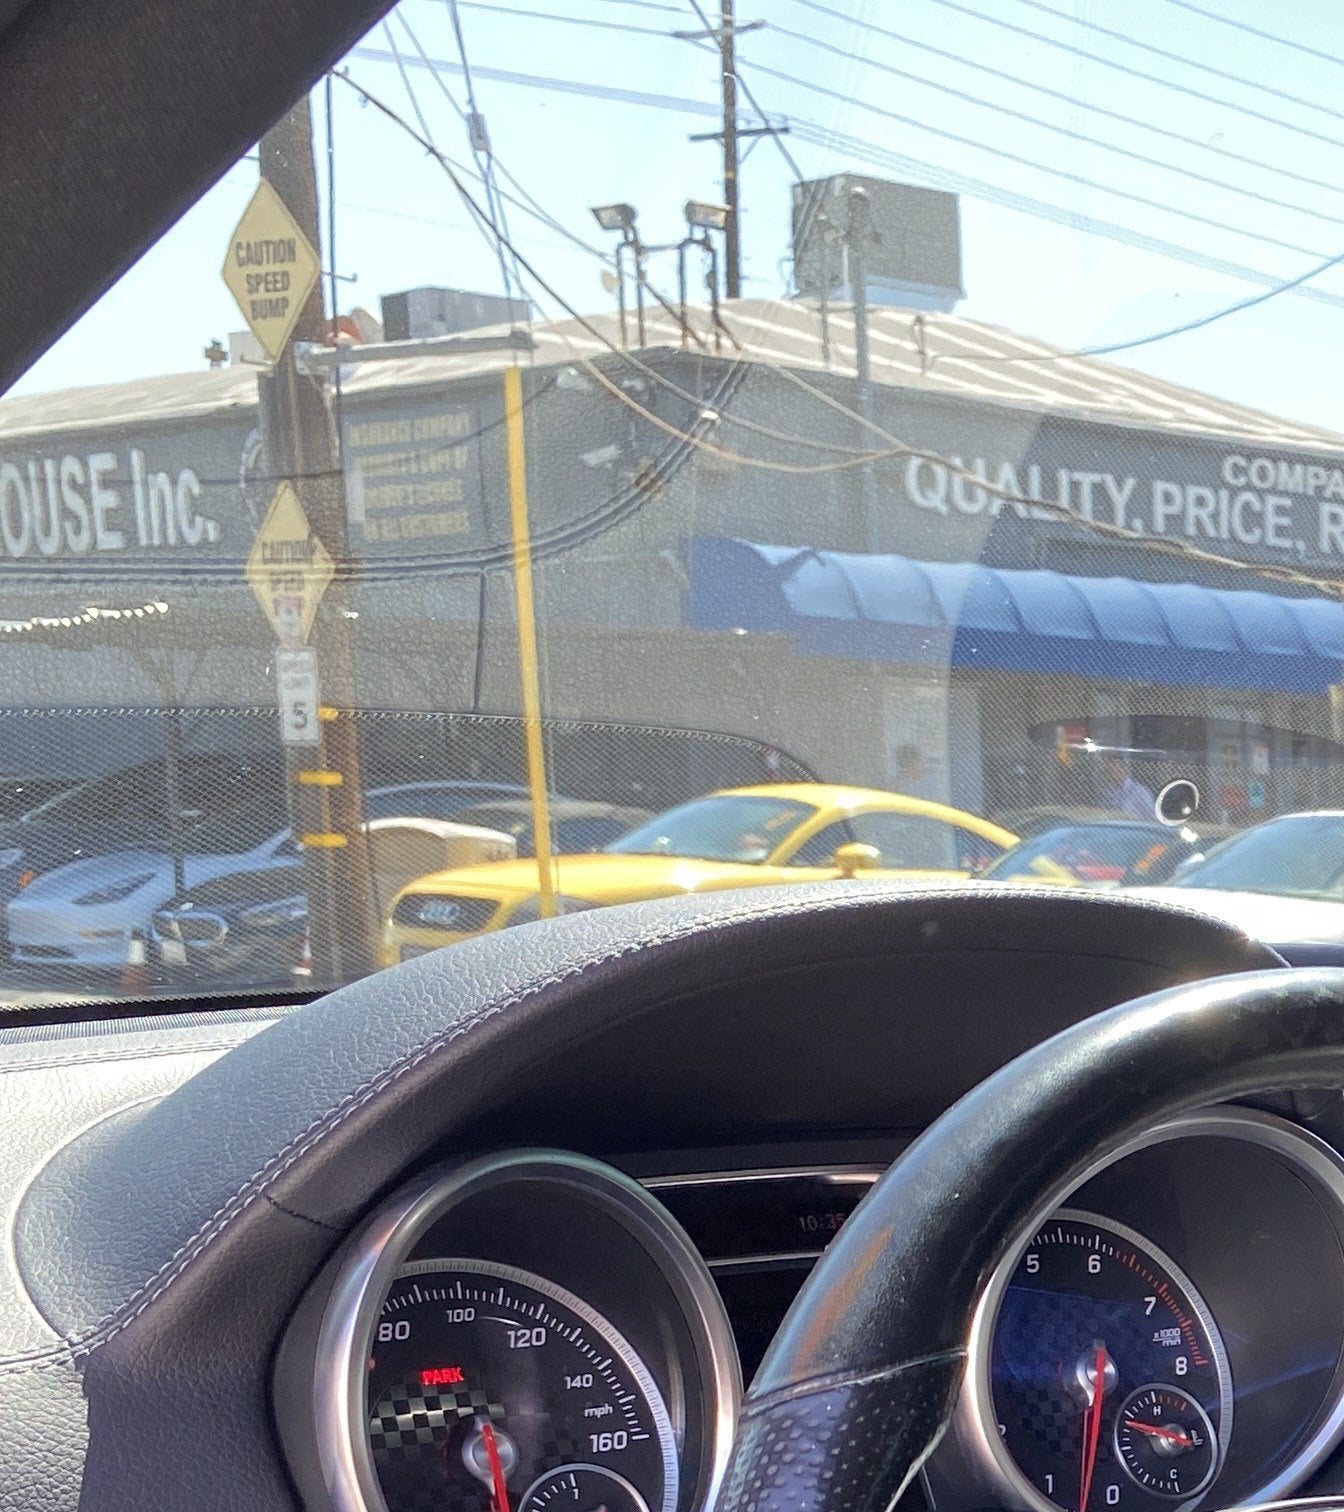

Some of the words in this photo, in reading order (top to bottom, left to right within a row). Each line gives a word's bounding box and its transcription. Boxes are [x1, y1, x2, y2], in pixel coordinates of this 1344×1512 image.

[236, 238, 296, 268] CAUTION
[246, 271, 290, 293] SPEED
[251, 297, 289, 320] BUMP
[0, 453, 125, 557] OUSE
[131, 448, 222, 545] Inc.
[292, 701, 308, 729] 5
[1026, 1254, 1040, 1273] 5
[1088, 1254, 1101, 1274] 6
[446, 1307, 475, 1323] 100
[1144, 1296, 1157, 1316] 7
[378, 1320, 411, 1342] 80
[507, 1327, 546, 1349] 120
[420, 1366, 465, 1386] PARK
[1175, 1356, 1188, 1376] 8
[565, 1374, 593, 1390] 140
[584, 1403, 614, 1418] mph
[1153, 1406, 1162, 1416] H
[589, 1431, 628, 1453] 160
[1169, 1468, 1178, 1480] C
[572, 1488, 579, 1500] 1
[1045, 1474, 1053, 1495] 1
[1106, 1485, 1120, 1505] 0
